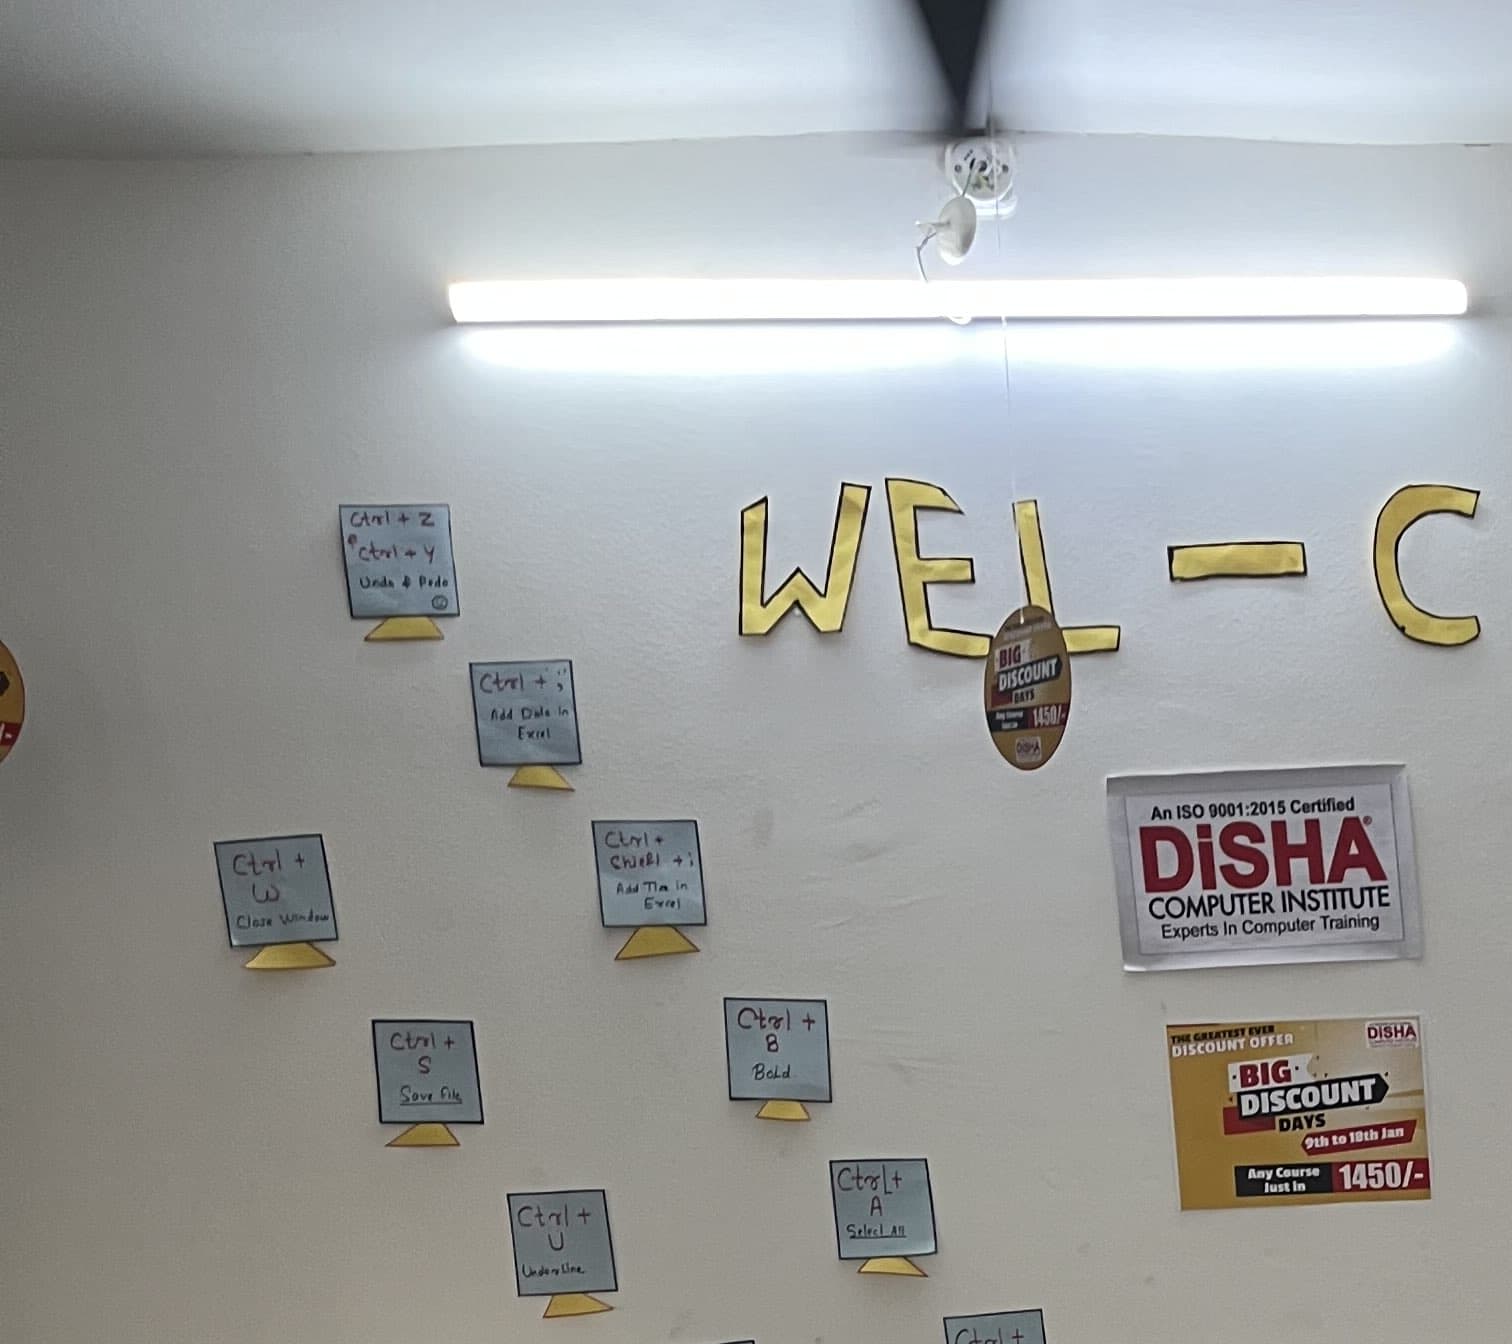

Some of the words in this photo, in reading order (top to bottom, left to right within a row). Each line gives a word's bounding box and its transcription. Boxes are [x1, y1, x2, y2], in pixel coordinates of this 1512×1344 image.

[350, 511, 391, 527] Ctrl
[398, 514, 410, 524] +
[419, 512, 435, 527] Z
[359, 541, 398, 562] Ctrl
[404, 547, 417, 559] +
[999, 644, 1021, 668] BIG
[480, 672, 524, 693] Ctrl
[536, 674, 547, 686] +
[999, 657, 1059, 691] DISCOUNT
[1033, 703, 1066, 728] 1450/-
[1151, 806, 1172, 821] An
[1177, 804, 1204, 820] ISO
[1209, 800, 1286, 818] 9001:2015
[1290, 797, 1355, 814] Certified
[605, 831, 649, 848] Ctrl
[233, 853, 281, 876] Ctrl
[295, 853, 305, 868] +
[673, 855, 684, 866] +
[1148, 891, 1276, 920] COMPUTER
[1281, 885, 1391, 913] INSTITUTE
[237, 914, 273, 930] Close
[1161, 922, 1219, 941] Experts
[1224, 921, 1238, 936] In
[1242, 917, 1316, 936] Computer
[1320, 914, 1380, 931] Training
[738, 1007, 791, 1030] Ctrl
[802, 1013, 816, 1031] +
[390, 1031, 436, 1050] Ctrl
[444, 1036, 456, 1050] +
[1171, 1034, 1192, 1045] THE
[1193, 1027, 1246, 1042] GREATEST
[1248, 1025, 1276, 1036] EVER
[1172, 1038, 1246, 1058] DISCOUNT
[1249, 1032, 1294, 1048] OFFER
[418, 1055, 432, 1075] S
[1239, 1059, 1292, 1088] BIG
[1240, 1078, 1376, 1117] DISCOUNT
[1278, 1113, 1326, 1132] DAYS
[1305, 1135, 1329, 1150] 9th
[1332, 1134, 1347, 1146] to
[1248, 1168, 1272, 1180] Any
[1275, 1166, 1320, 1178] Course
[1339, 1160, 1424, 1190] 1450/-
[518, 1204, 569, 1227] Ctrl
[578, 1207, 591, 1224] +
[870, 1195, 882, 1216] A
[548, 1232, 565, 1251] U
